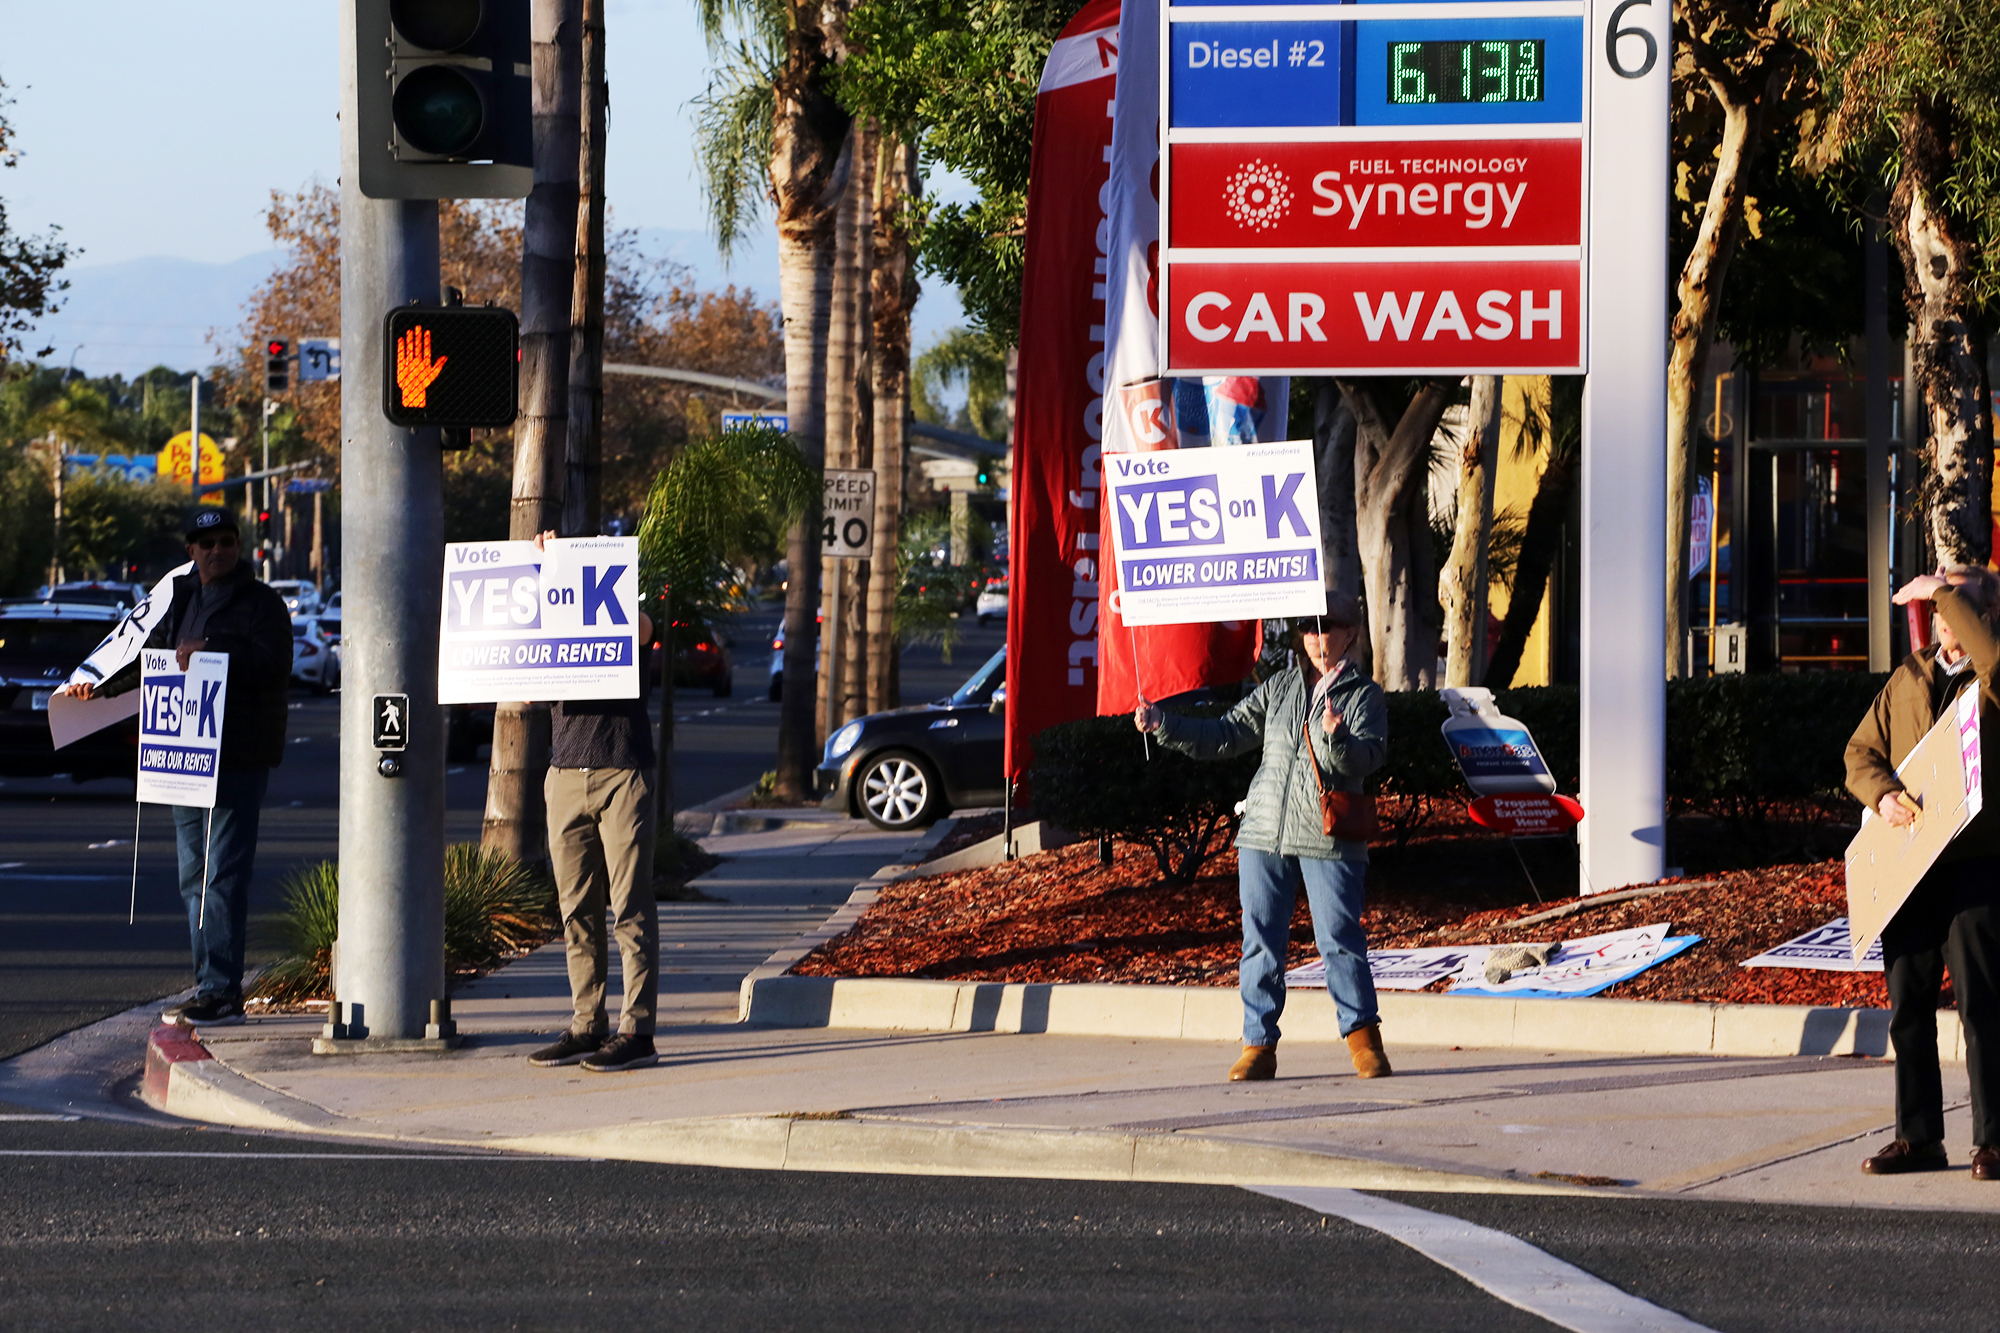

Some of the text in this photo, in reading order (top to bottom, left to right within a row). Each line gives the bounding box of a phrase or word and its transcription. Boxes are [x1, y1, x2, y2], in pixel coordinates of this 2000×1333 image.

[1606, 0, 1657, 78] 6
[1188, 40, 1326, 69] Diesel #2
[1393, 42, 1509, 103] 6.13
[1349, 157, 1528, 175] FUEL TECHNOLOGY
[1312, 171, 1528, 230] Synergy
[1185, 289, 1562, 343] CAR WASH
[1117, 458, 1170, 477] Vote
[824, 478, 870, 493] PEED
[824, 497, 862, 511] IMIT
[1119, 472, 1312, 544] YES on K
[822, 516, 868, 548] 40
[454, 546, 501, 564] Vote
[1132, 555, 1308, 587] LOWER OUR RENTS!
[451, 564, 629, 627] YES on K
[145, 653, 167, 671] Vote
[453, 641, 624, 667] LOWER OUR RENTS!
[143, 679, 222, 739] YES on K
[142, 748, 213, 772] LOWER OUR RENTS!
[1960, 704, 1979, 794] YES
[1494, 799, 1550, 809] Propane
[1495, 808, 1559, 819] Exchange
[1515, 818, 1548, 828] Here
